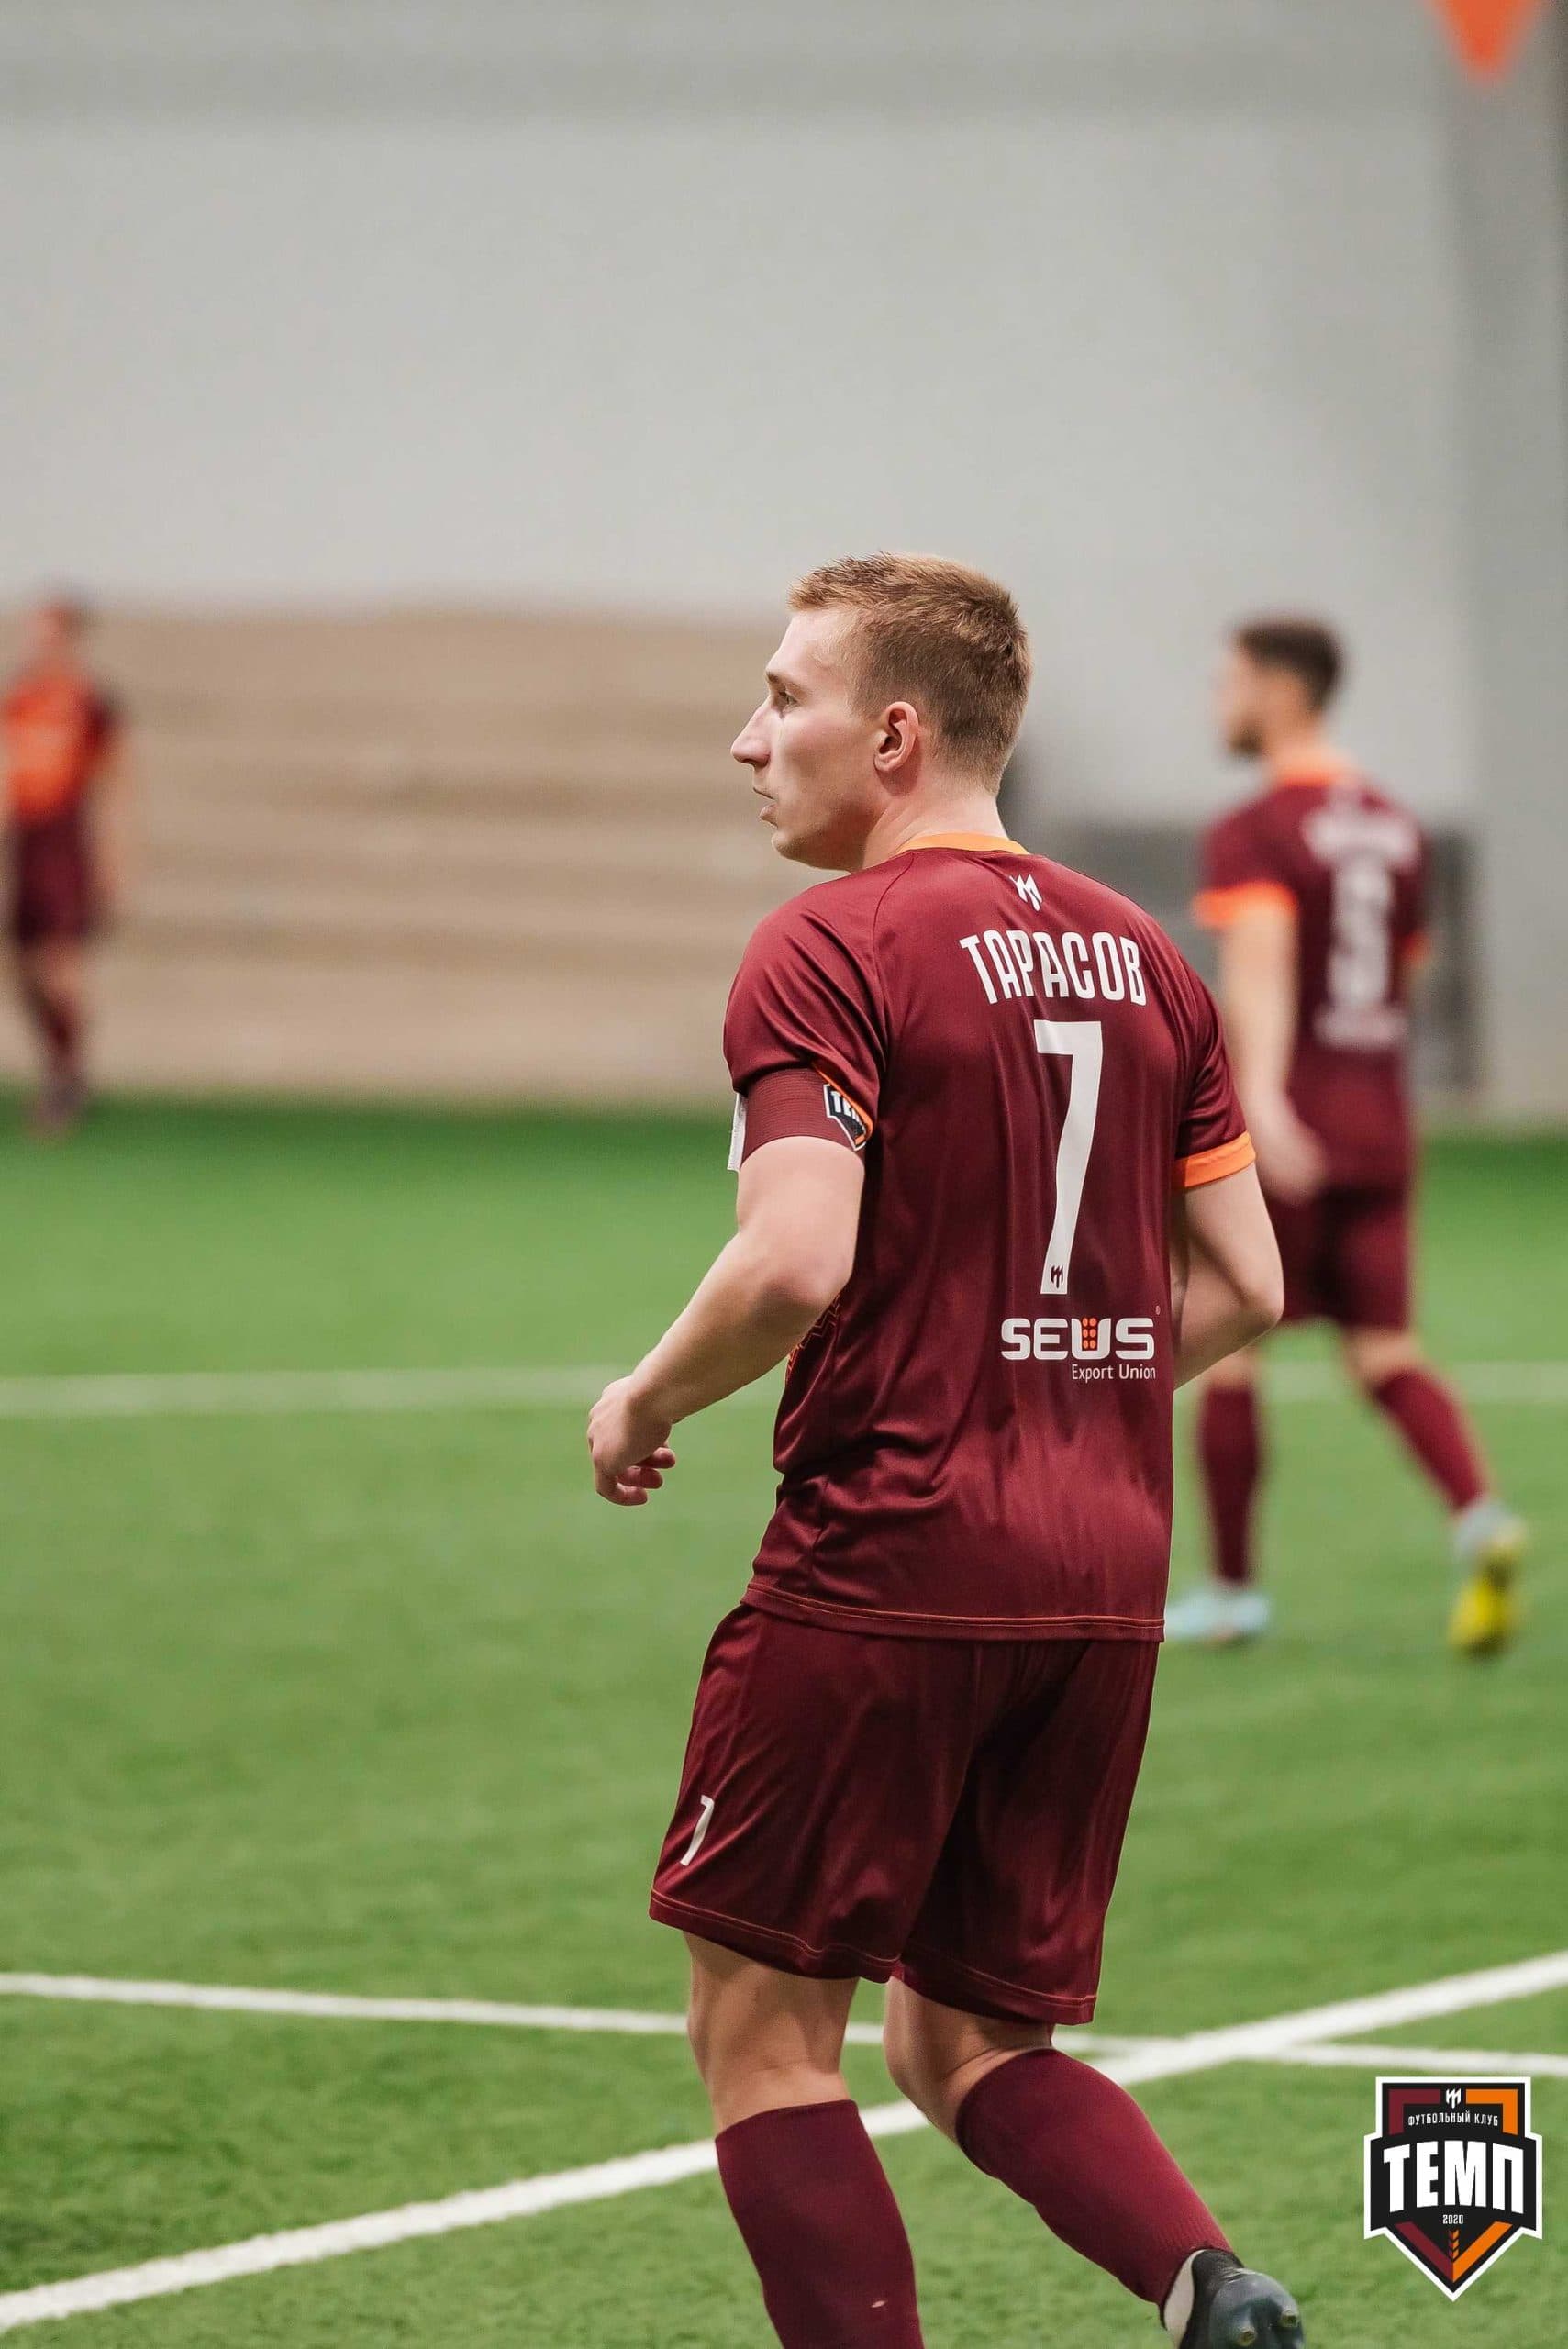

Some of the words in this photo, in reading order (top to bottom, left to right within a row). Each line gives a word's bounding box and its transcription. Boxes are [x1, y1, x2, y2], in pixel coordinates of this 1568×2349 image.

[1034, 1020, 1103, 1295] 7
[1001, 1318, 1155, 1360] SEUS
[1072, 1364, 1113, 1383] Export
[1119, 1364, 1156, 1380] Union
[680, 1794, 715, 1866] 7
